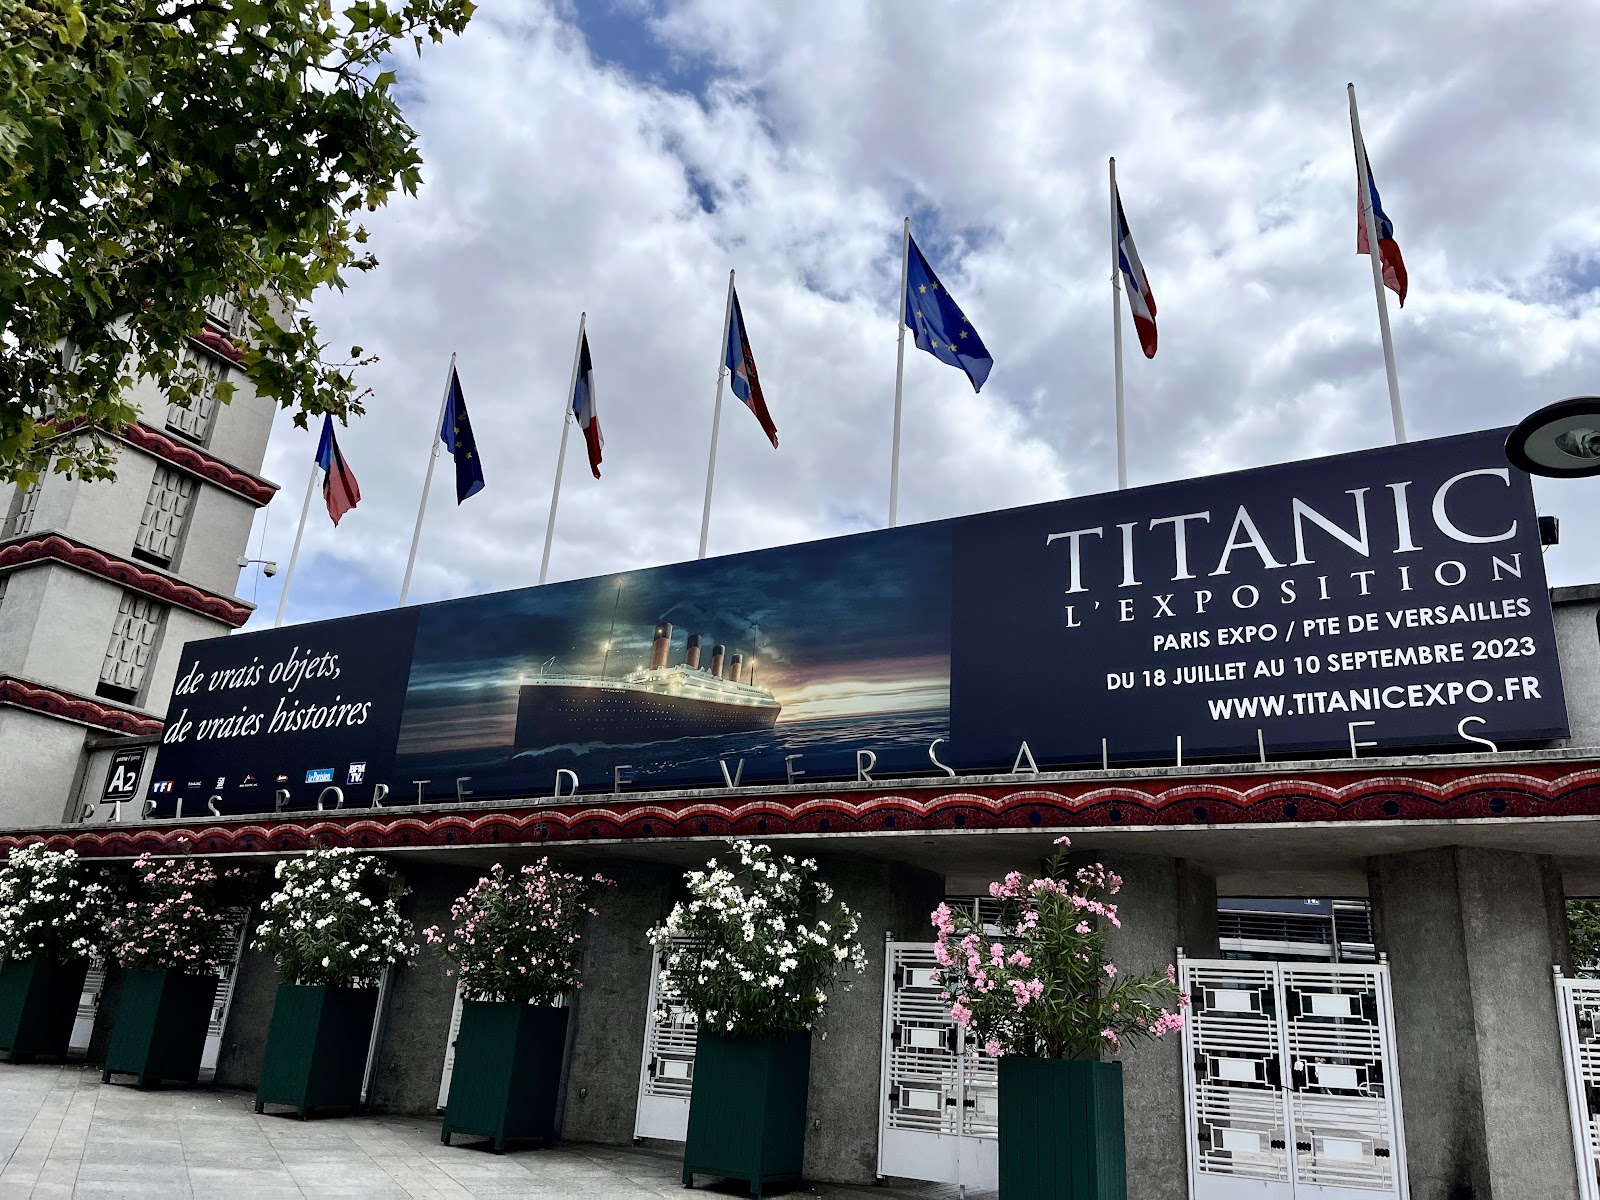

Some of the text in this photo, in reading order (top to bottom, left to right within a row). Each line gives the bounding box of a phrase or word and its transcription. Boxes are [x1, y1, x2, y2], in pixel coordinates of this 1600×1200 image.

[1046, 467, 1520, 595] TITANIC
[1065, 553, 1523, 628] L'EXPOSITION
[1153, 597, 1532, 652] PARIS EXPO / PTE DE VERSAILLES
[176, 645, 341, 696] de vrais objets,
[1106, 636, 1537, 691] DU 18 JUILLET AU 10 SEPTEMBRE 2023
[163, 695, 372, 745] de vraies histoires
[1207, 675, 1542, 721] WWW.TITANICEXPO.FR
[107, 765, 136, 793] A2
[153, 781, 173, 793] TF1
[349, 763, 366, 774] BFM
